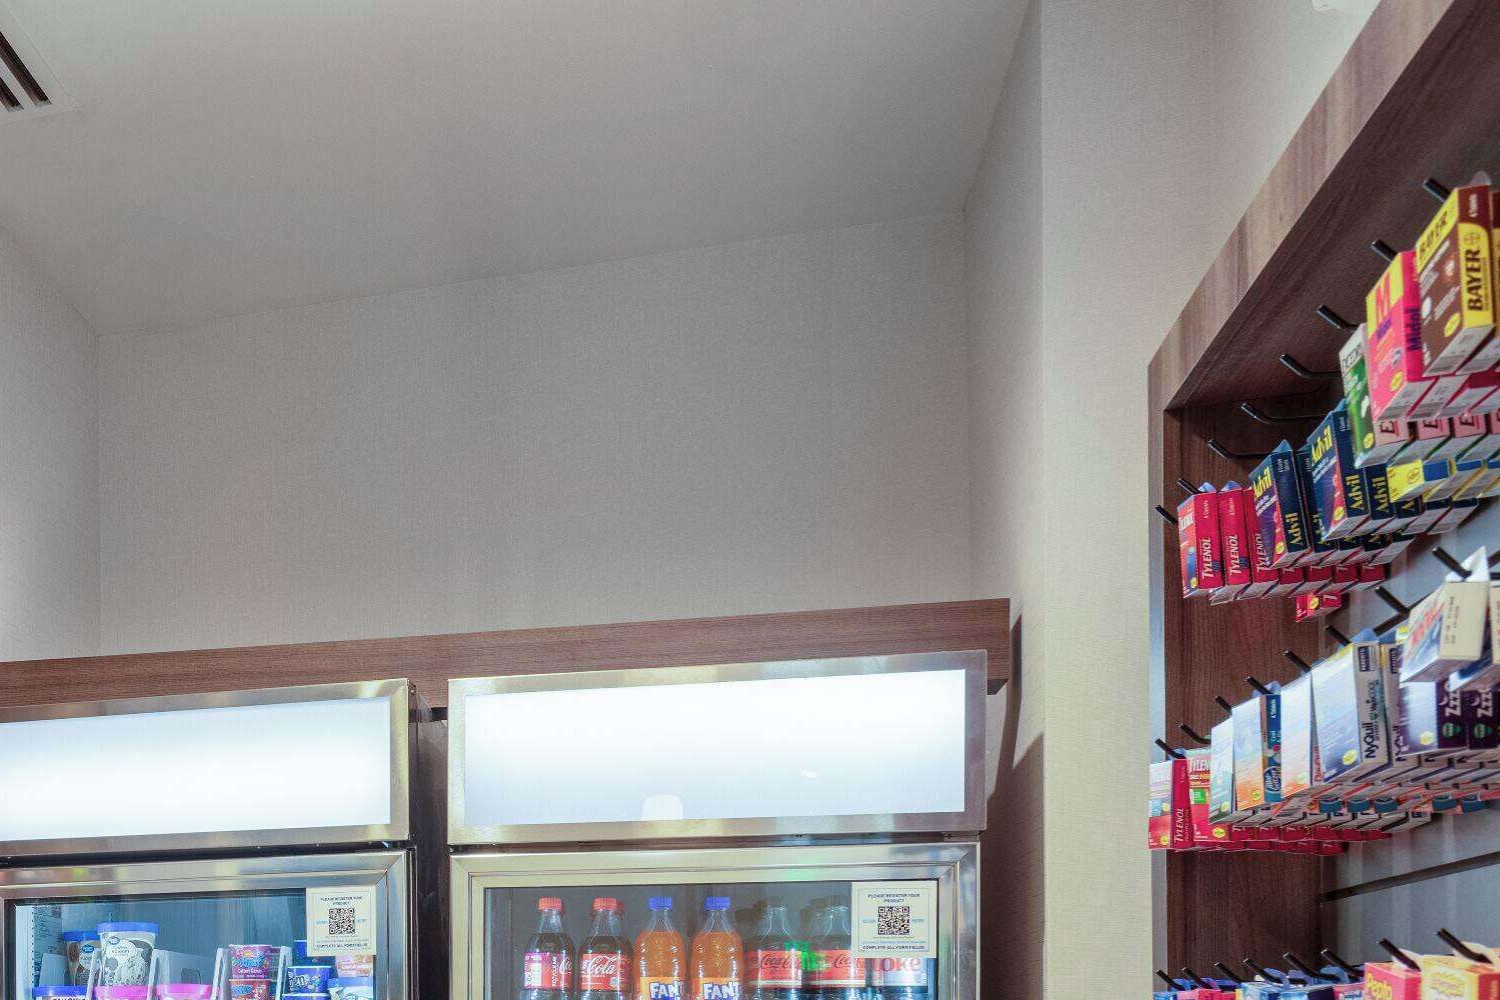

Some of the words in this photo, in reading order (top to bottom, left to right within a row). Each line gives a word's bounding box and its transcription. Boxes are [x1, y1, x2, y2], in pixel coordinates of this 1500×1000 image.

[1467, 248, 1482, 312] BAYER
[1311, 425, 1334, 464] Advil
[1252, 466, 1274, 502] Advil
[1345, 474, 1366, 510] Advil
[1372, 476, 1390, 513] Advil
[1285, 512, 1303, 547] Advil
[1201, 537, 1216, 581] TYLENOL
[1229, 534, 1243, 577] TYLENOL
[1364, 721, 1374, 760] NyQuil
[1173, 807, 1184, 843] TYLENOL
